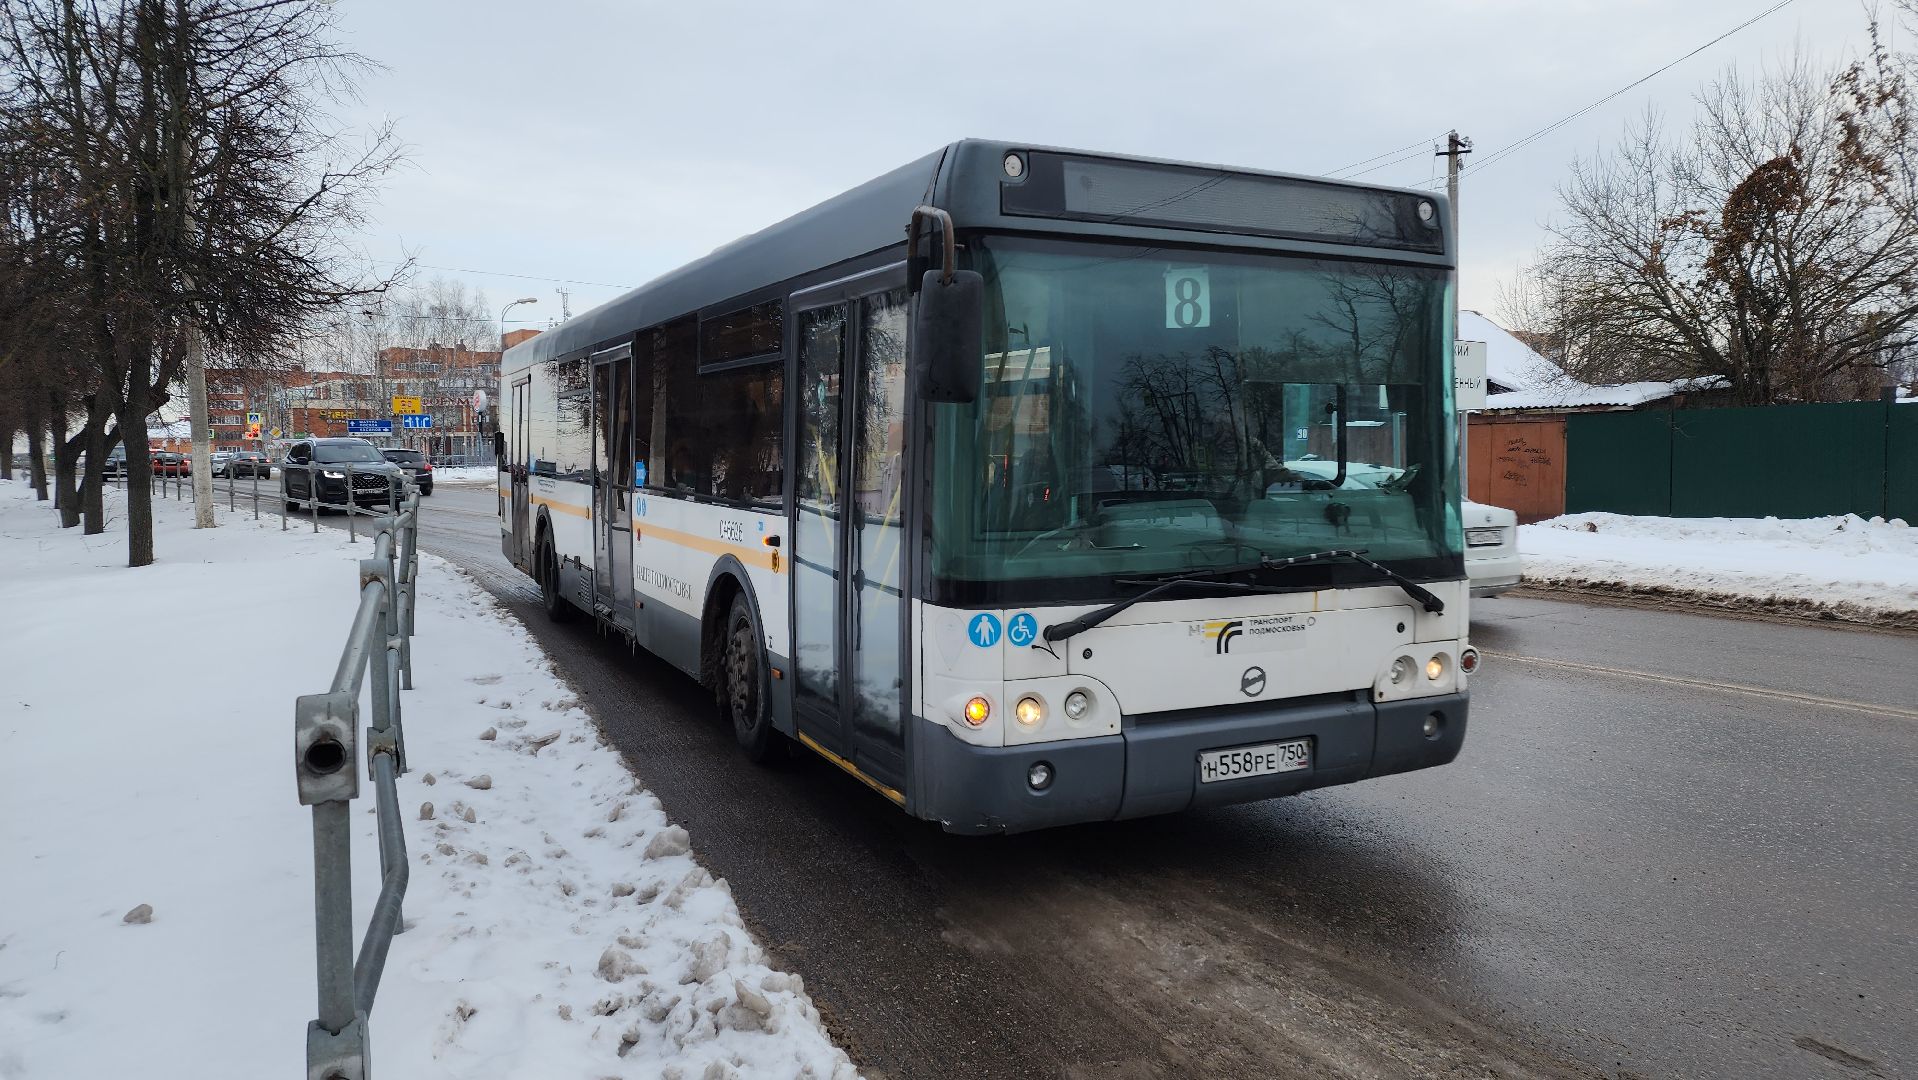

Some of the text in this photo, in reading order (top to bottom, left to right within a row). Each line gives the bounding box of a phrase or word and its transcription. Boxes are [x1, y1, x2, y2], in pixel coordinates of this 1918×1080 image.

[1174, 277, 1202, 329] 8
[1249, 616, 1293, 627] ТРАНСПОРТ
[1249, 624, 1306, 635] ПОДМОСКОВЬЯ
[1207, 743, 1304, 778] Н558РЕ 750
